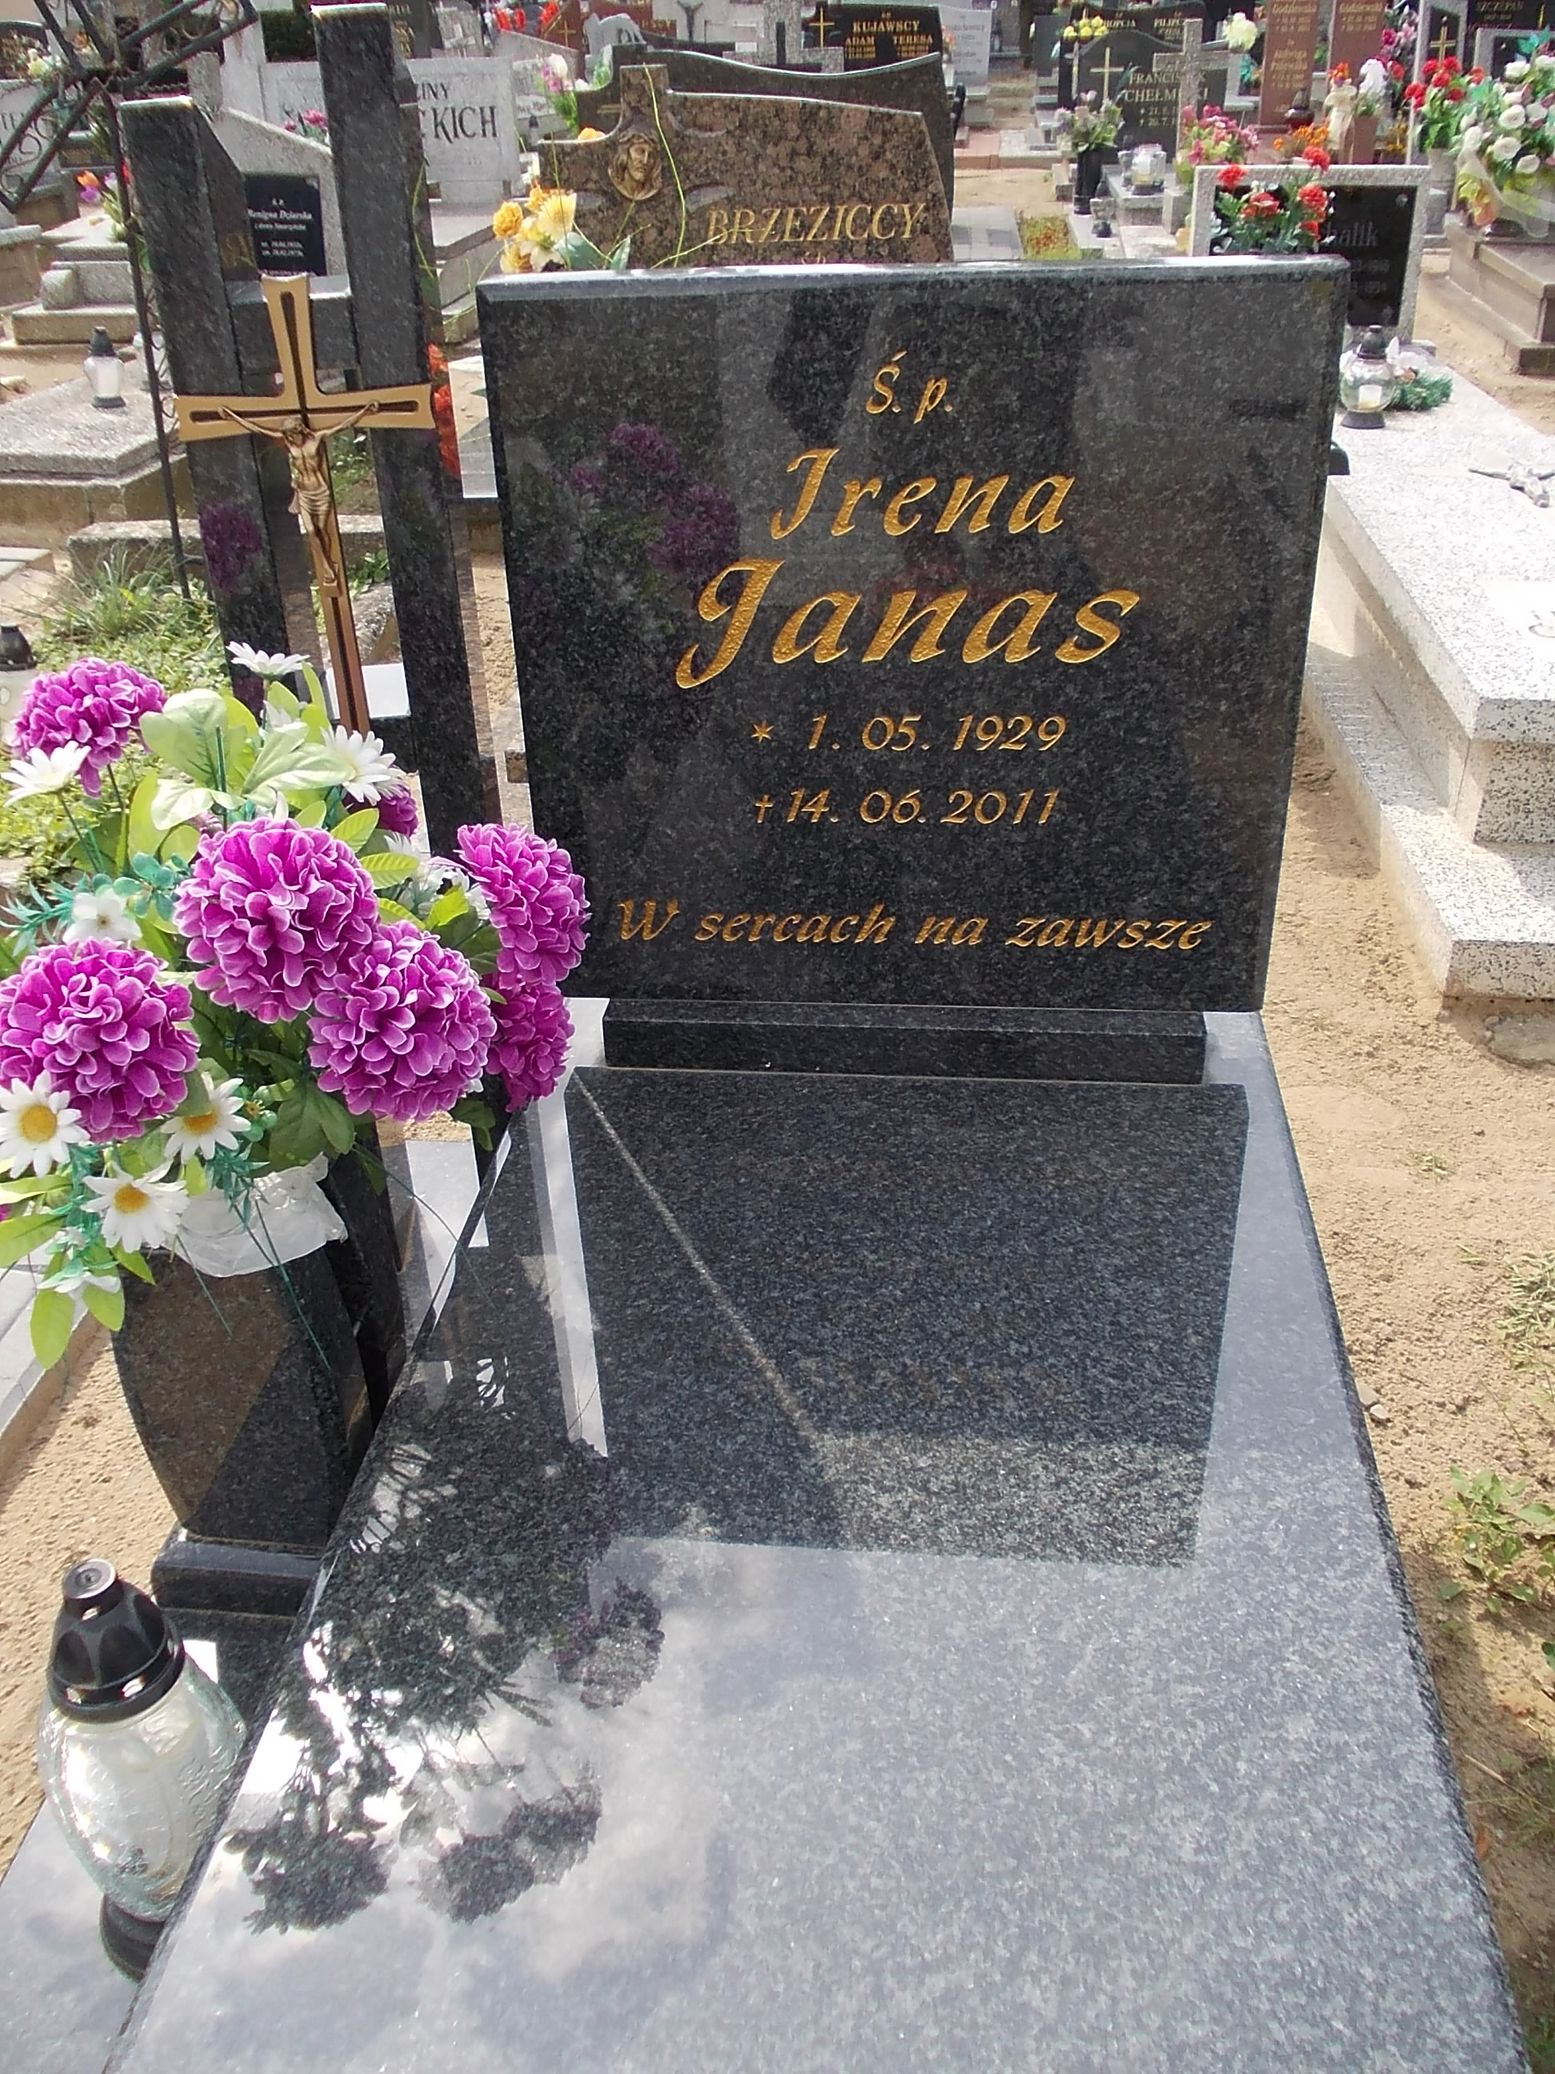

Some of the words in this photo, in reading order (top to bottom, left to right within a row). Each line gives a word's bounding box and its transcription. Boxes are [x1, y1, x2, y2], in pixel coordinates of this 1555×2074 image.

[852, 20, 920, 33] KUJAWSCY
[706, 203, 926, 246] BRZEZICCY
[865, 350, 907, 415] Ś.
[914, 374, 954, 424] p.
[770, 447, 1076, 540] Irena
[675, 557, 1141, 690] Janas
[808, 713, 841, 751] 1.
[861, 713, 930, 751] 05.
[953, 713, 1067, 752] 1929
[786, 788, 840, 824] 14.
[858, 789, 927, 825] 06.
[939, 788, 1060, 825] 2011
[616, 897, 680, 941] W
[694, 901, 897, 944] sercach
[914, 915, 989, 946] na
[1004, 917, 1213, 950] zawsze
